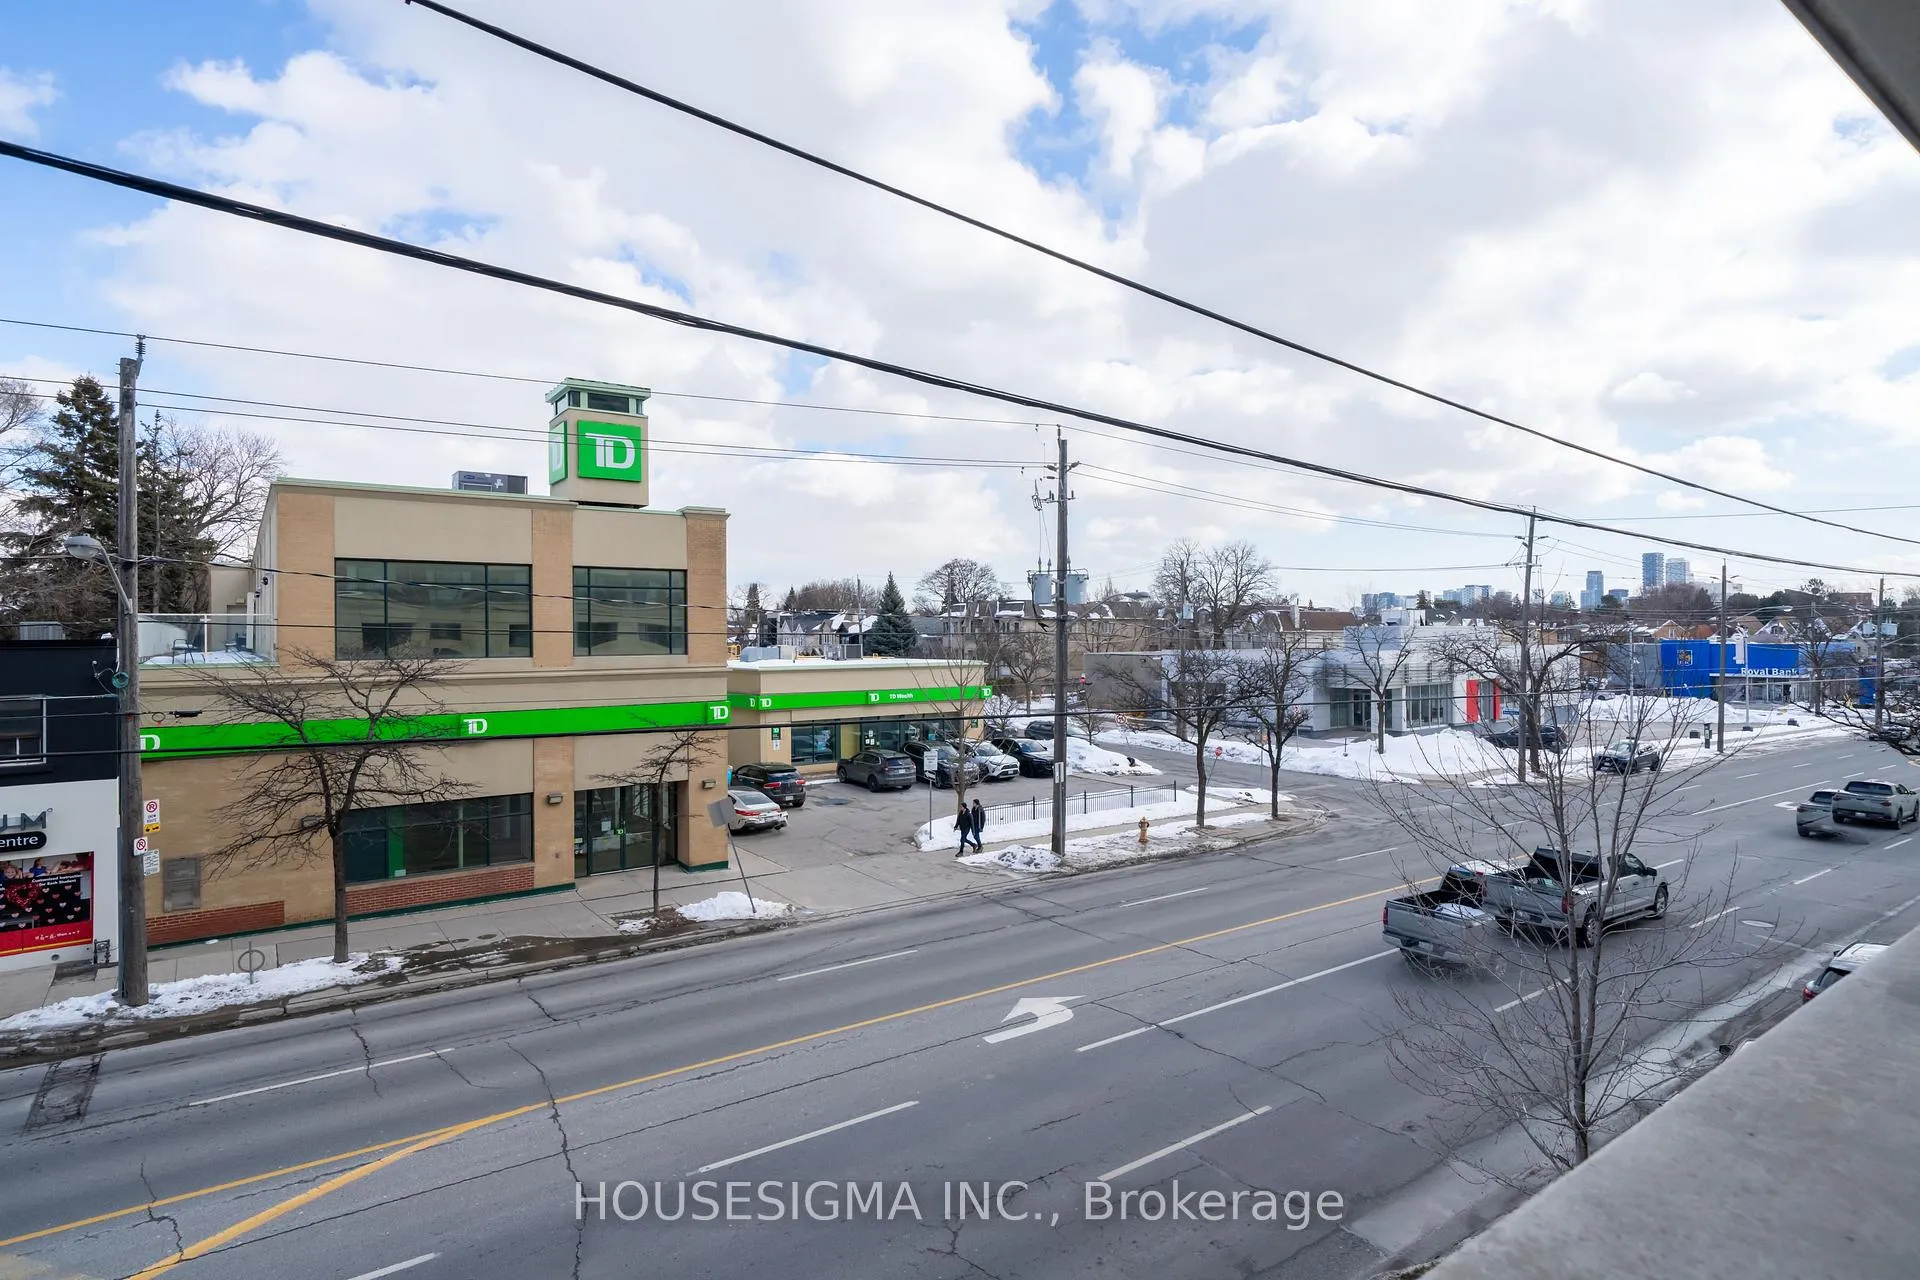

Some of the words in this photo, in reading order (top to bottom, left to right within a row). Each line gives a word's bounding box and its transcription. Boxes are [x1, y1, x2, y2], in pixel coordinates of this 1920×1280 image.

[585, 433, 635, 469] TD
[1740, 667, 1769, 677] Royal
[1771, 668, 1799, 677] Bank
[868, 693, 879, 702] TD
[981, 688, 991, 697] TD
[760, 697, 772, 708] TD
[710, 705, 729, 720] TD
[463, 718, 488, 735] TD
[140, 734, 161, 751] D
